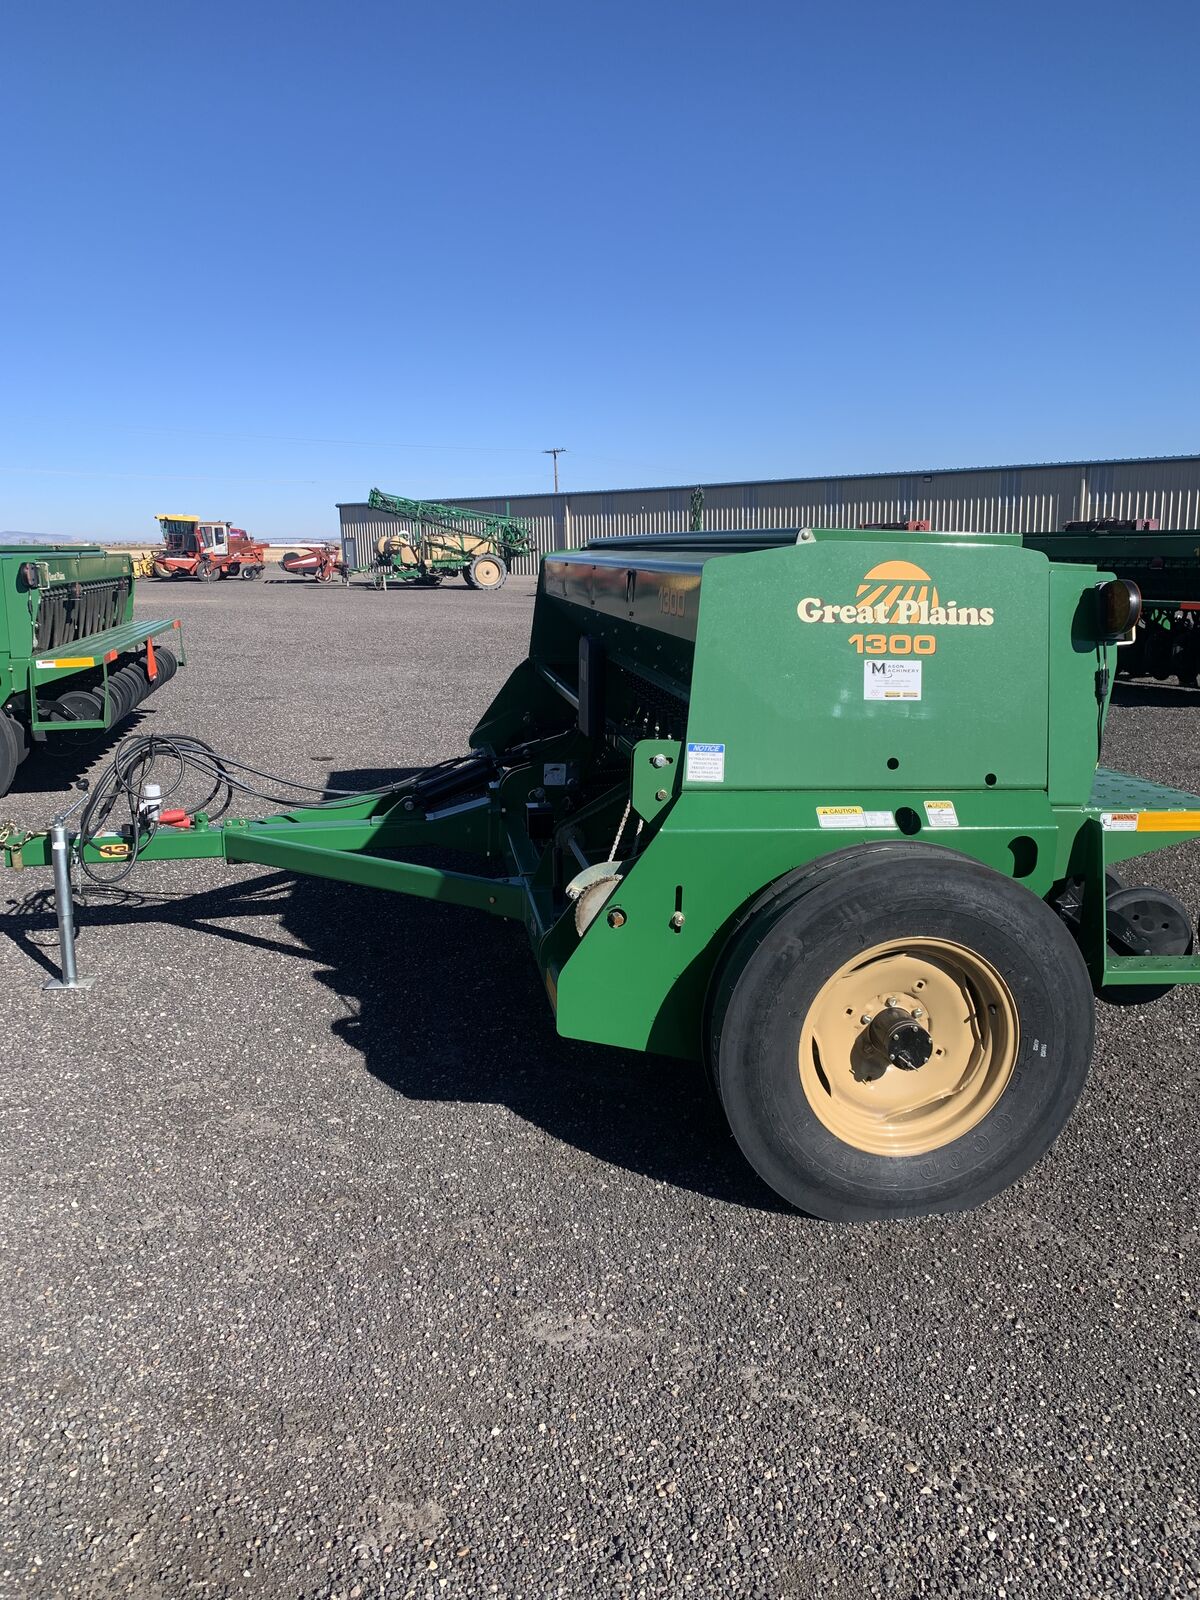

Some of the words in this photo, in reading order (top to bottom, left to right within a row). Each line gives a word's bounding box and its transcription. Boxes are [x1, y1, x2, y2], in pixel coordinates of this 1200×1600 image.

[658, 586, 685, 617] 1300
[796, 597, 890, 624] Great
[896, 599, 995, 626] Plains
[848, 633, 937, 655] 1300
